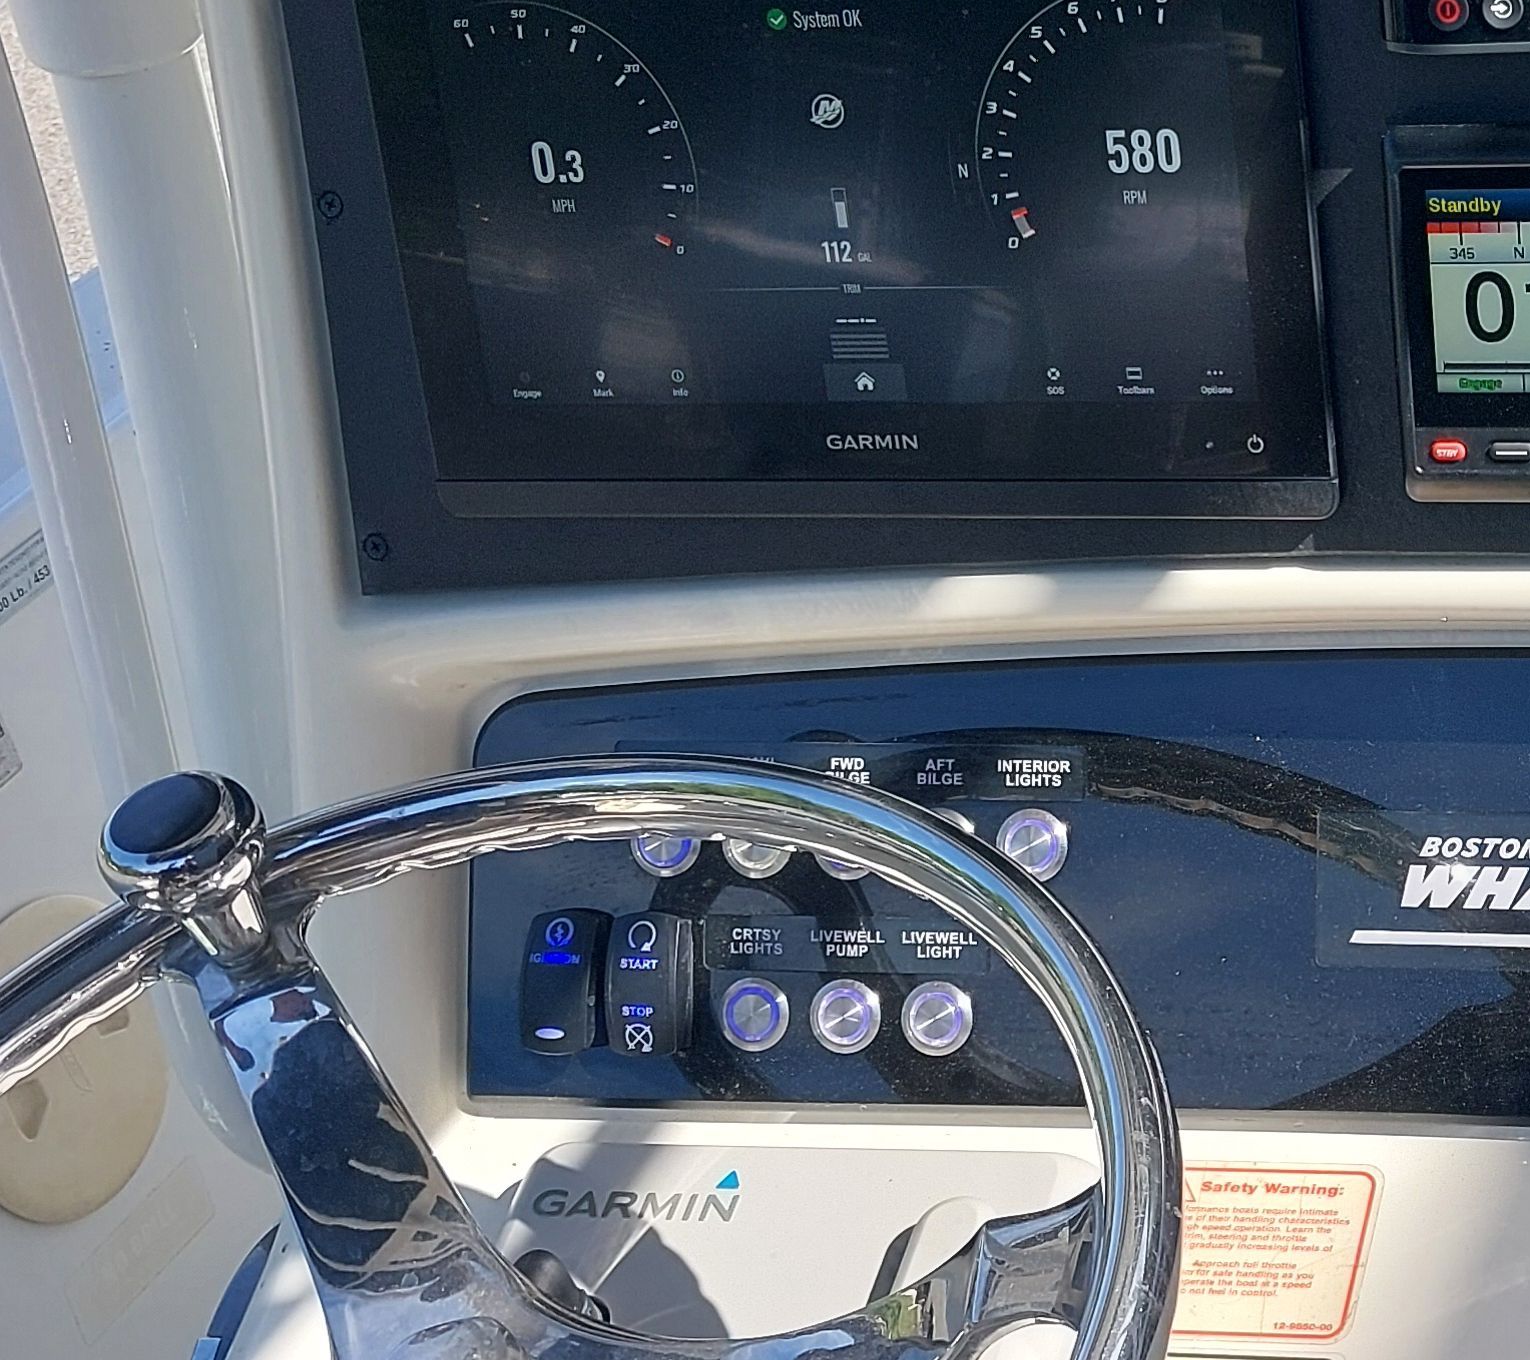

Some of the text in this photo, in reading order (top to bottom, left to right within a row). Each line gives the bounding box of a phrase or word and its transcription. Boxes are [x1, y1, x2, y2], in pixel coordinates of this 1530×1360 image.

[510, 8, 527, 19] 50
[1067, 2, 1079, 15] 6
[453, 18, 469, 29] 60
[792, 9, 863, 31] System OK
[570, 24, 587, 34] 40
[1030, 26, 1043, 39] 5
[623, 63, 640, 74] 30
[1002, 60, 1015, 73] 4
[985, 102, 998, 114] 3
[662, 119, 679, 130] 20
[981, 147, 994, 159] 2
[1105, 128, 1182, 174] 580
[531, 140, 585, 184] 0.3
[957, 163, 970, 179] N
[680, 183, 695, 194] 10
[991, 193, 1000, 205] 1
[1123, 190, 1148, 206] RPM
[552, 198, 576, 214] MPH
[1428, 197, 1502, 217] Standby
[1007, 236, 1020, 249] 0
[676, 245, 685, 255] 0
[821, 240, 853, 263] 112
[1449, 247, 1475, 260] 345
[1513, 247, 1525, 260] N
[1046, 385, 1234, 397] SOS Toolbars Options
[826, 434, 919, 451] GARMIN
[830, 757, 865, 770] FWD
[925, 758, 955, 772] AFT
[997, 758, 1071, 773] INTERIOR
[825, 771, 871, 785] LGE
[917, 772, 963, 786] BILGE
[1005, 773, 1062, 787] LIGHTS
[732, 928, 781, 942] CRTSY
[810, 930, 885, 945] LIVEWELL
[901, 931, 978, 946] LIVEWELL
[729, 942, 783, 956] LIGHTS
[826, 944, 869, 958] PUMP
[916, 945, 964, 959] LIGHT
[529, 953, 580, 964] IGON
[619, 958, 659, 971] START
[621, 1005, 654, 1018] STOP
[1201, 1181, 1345, 1197] Safety Warning:
[532, 1189, 740, 1223] GARMIN
[1233, 1216, 1276, 1224] handling
